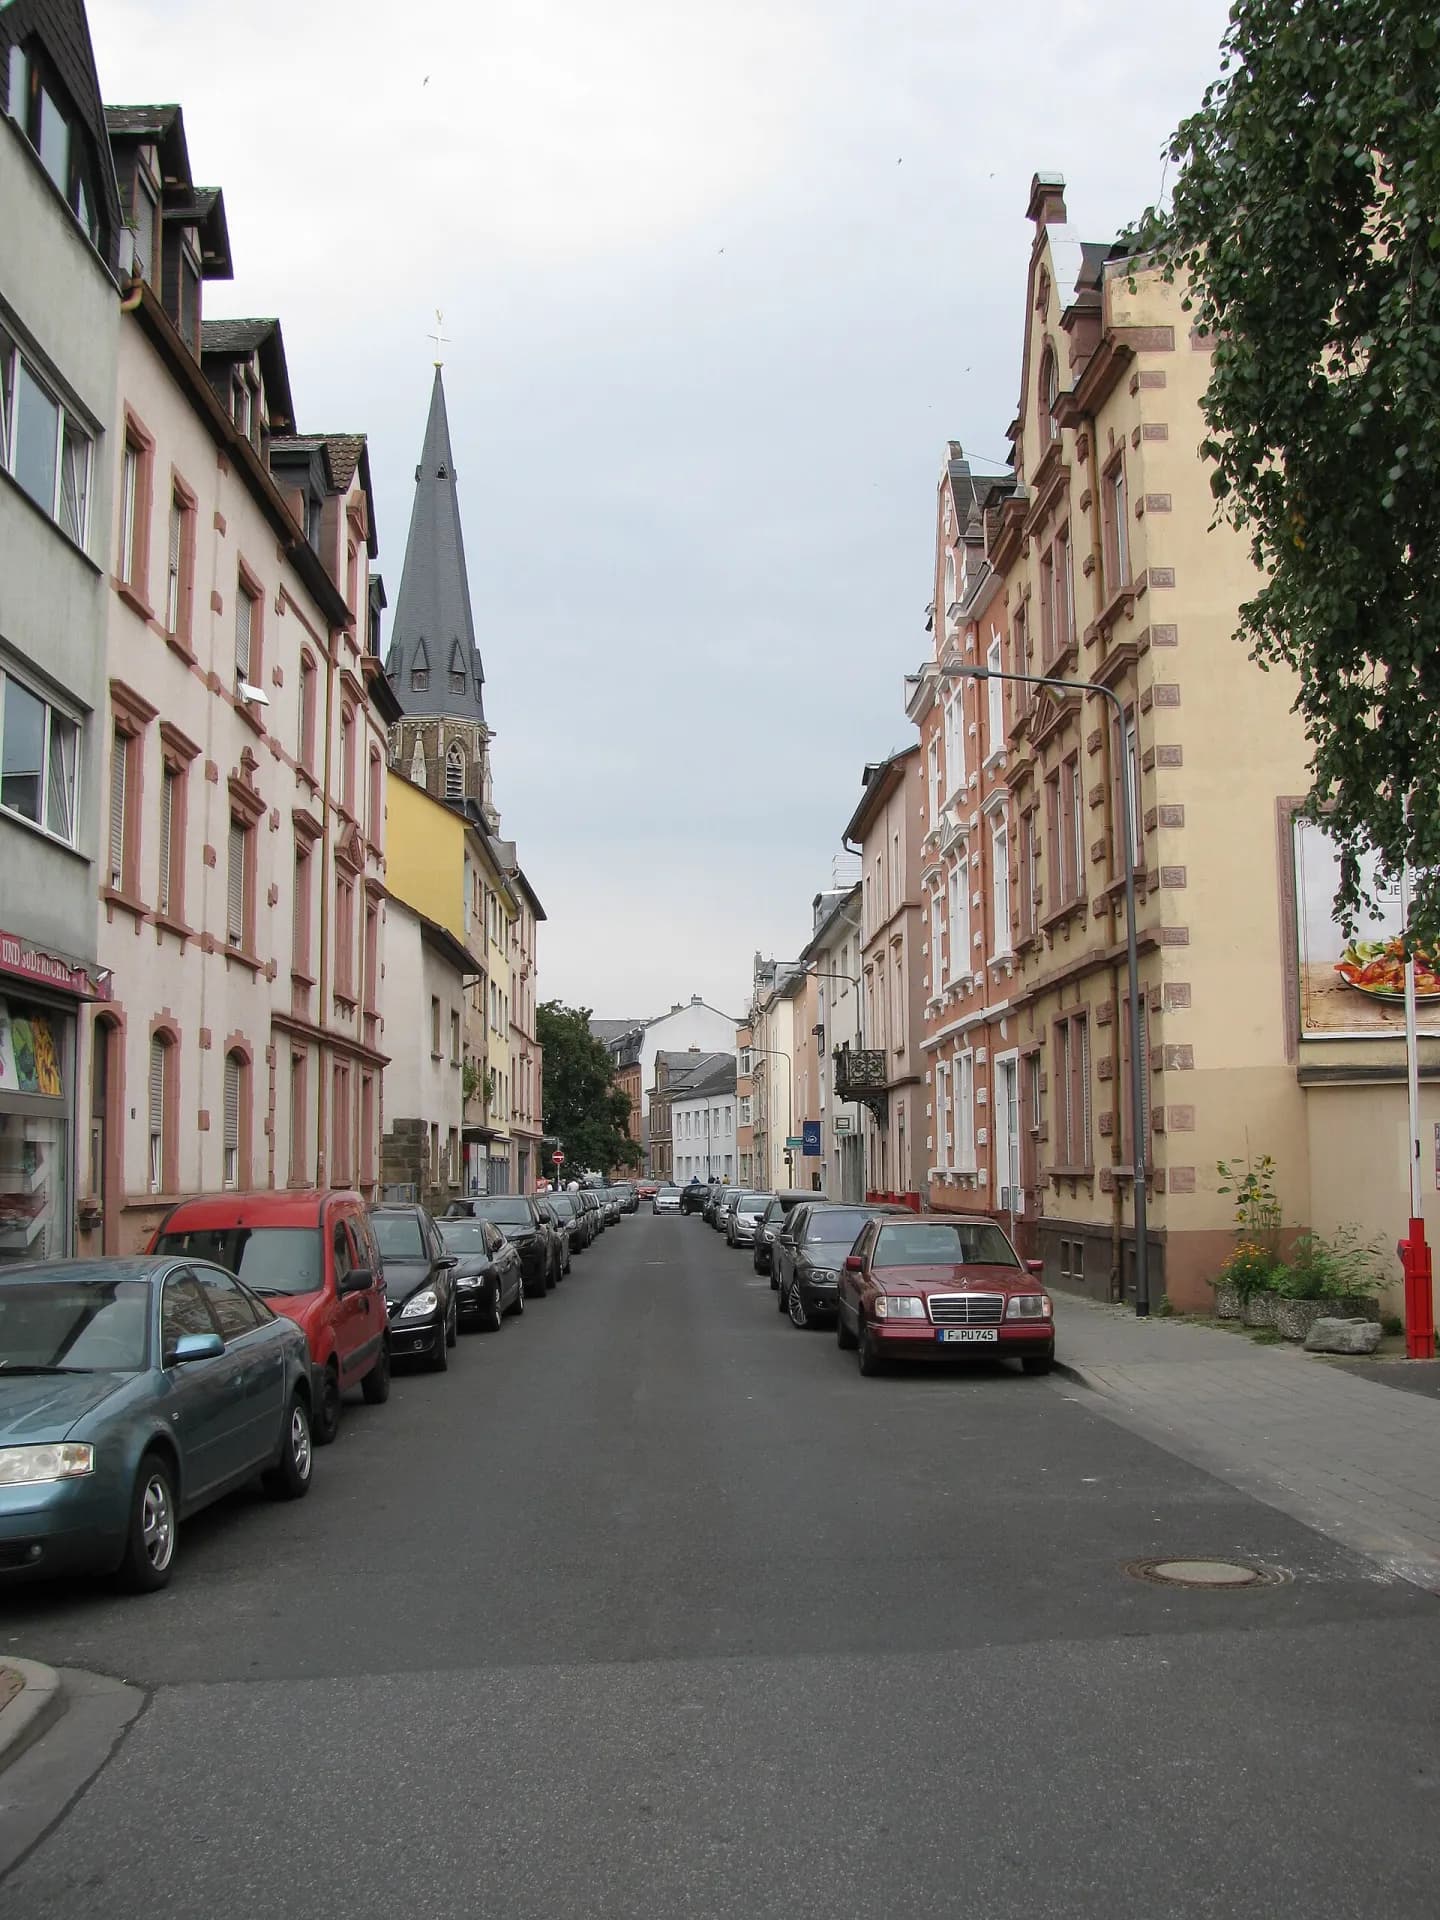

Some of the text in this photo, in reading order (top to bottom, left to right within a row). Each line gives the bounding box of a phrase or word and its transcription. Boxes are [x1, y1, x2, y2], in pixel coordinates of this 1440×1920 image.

[2, 939, 20, 966] UND
[948, 1330, 954, 1340] F
[976, 1330, 994, 1340] 745
